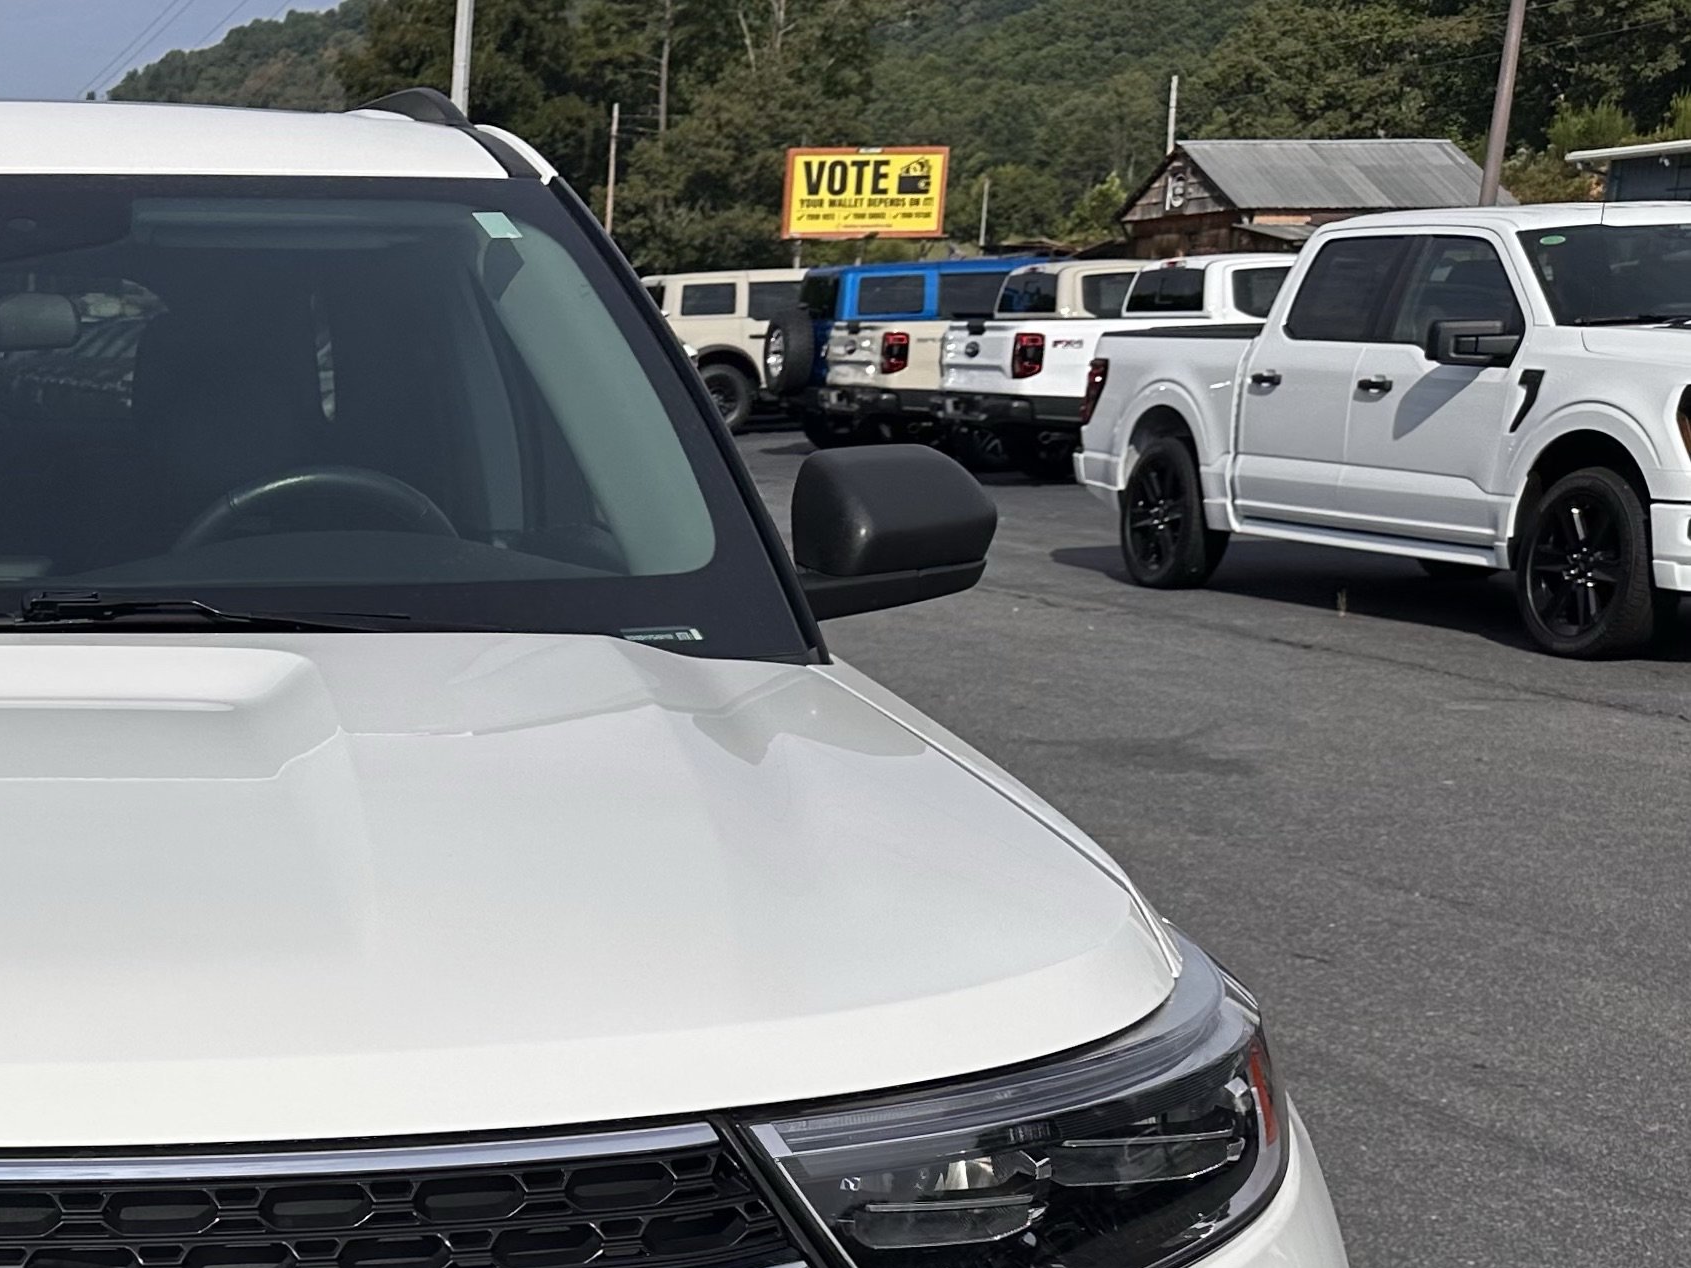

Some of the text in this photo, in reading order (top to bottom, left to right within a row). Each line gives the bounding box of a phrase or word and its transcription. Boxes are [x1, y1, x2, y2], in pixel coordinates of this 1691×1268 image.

[803, 159, 891, 196] VOTE
[799, 198, 824, 208] YOUR
[828, 197, 865, 208] WALLET
[867, 197, 906, 208] DEPENDS
[909, 197, 920, 207] ON
